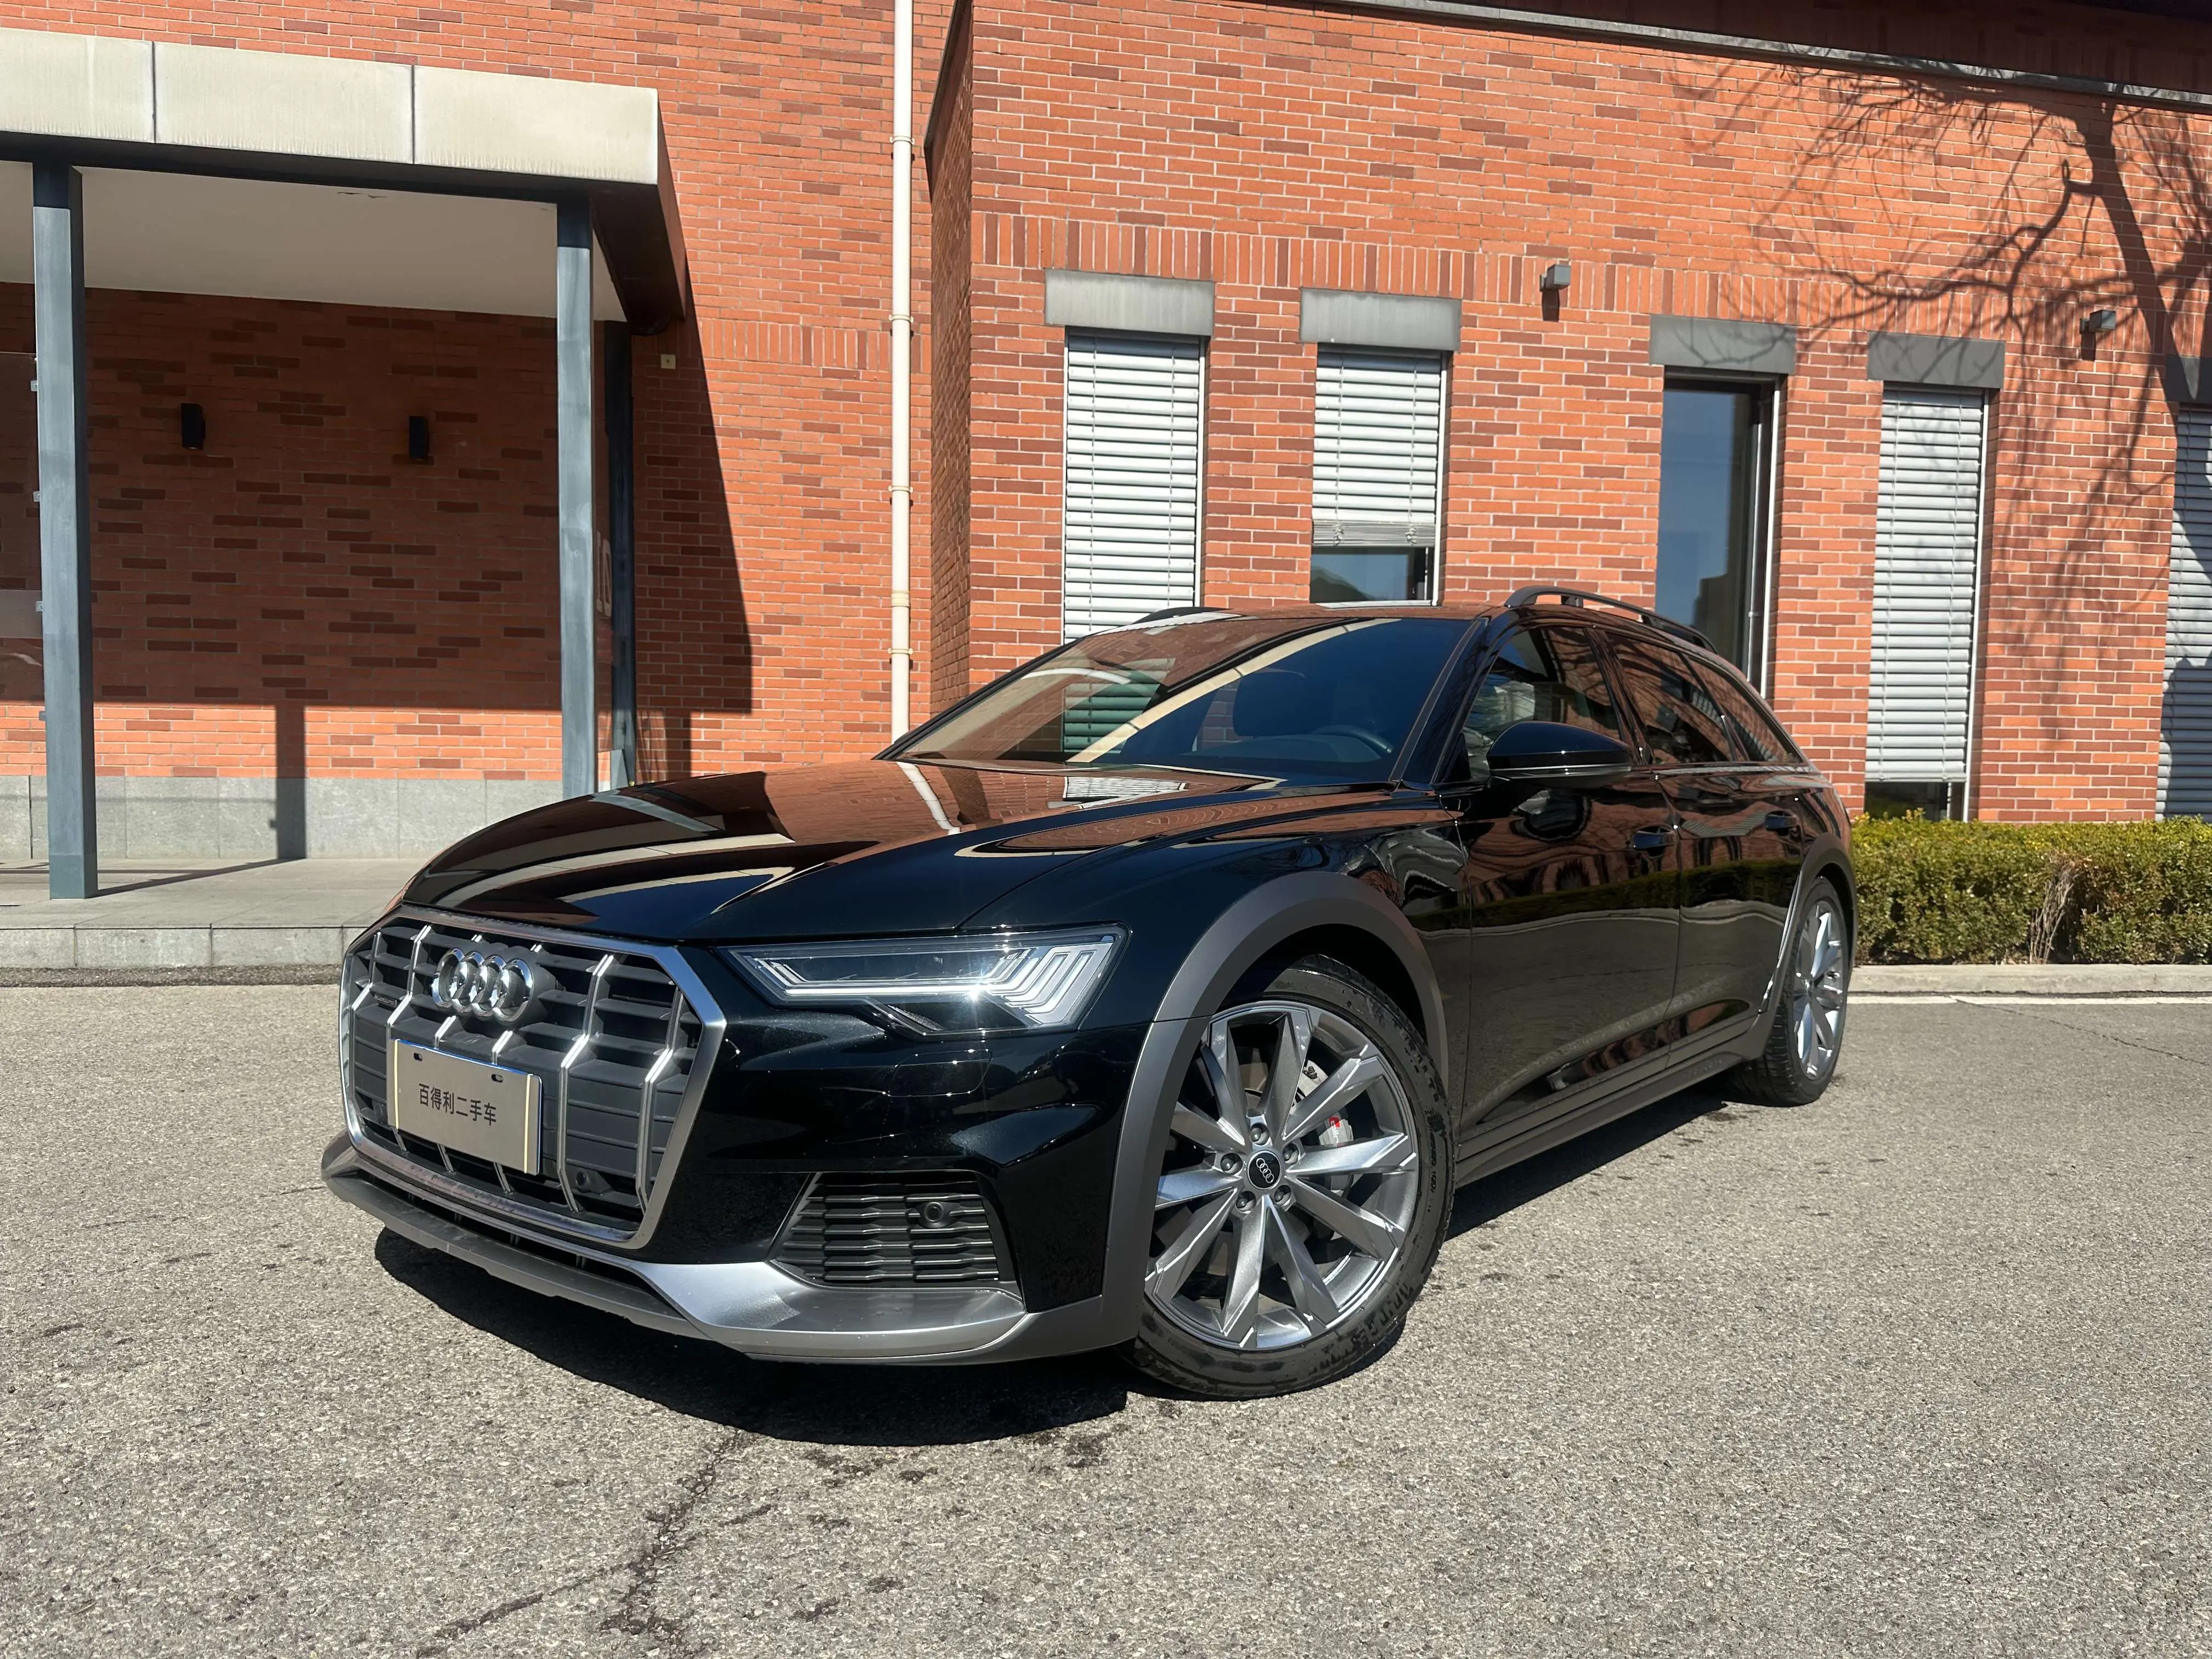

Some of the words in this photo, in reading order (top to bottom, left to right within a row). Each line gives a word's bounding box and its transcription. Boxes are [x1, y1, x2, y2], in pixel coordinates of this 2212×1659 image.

[419, 1083, 496, 1126] 百得利二手车
